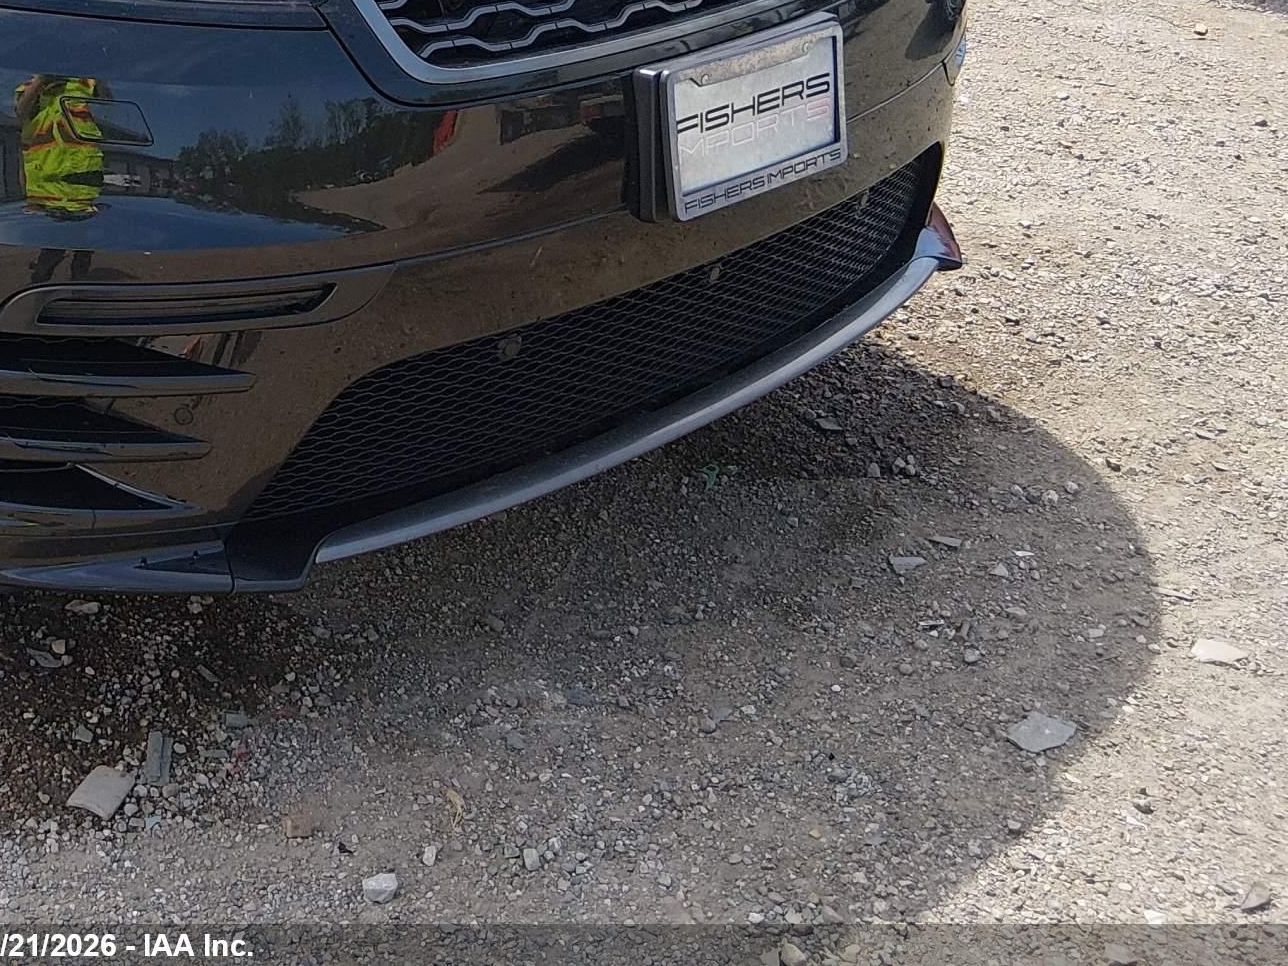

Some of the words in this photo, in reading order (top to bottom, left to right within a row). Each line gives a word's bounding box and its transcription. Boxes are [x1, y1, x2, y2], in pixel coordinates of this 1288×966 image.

[676, 72, 830, 134] FISHERS
[678, 96, 831, 158] MPORTS
[683, 174, 765, 215] FISHERS
[766, 146, 841, 185] IMPORTS
